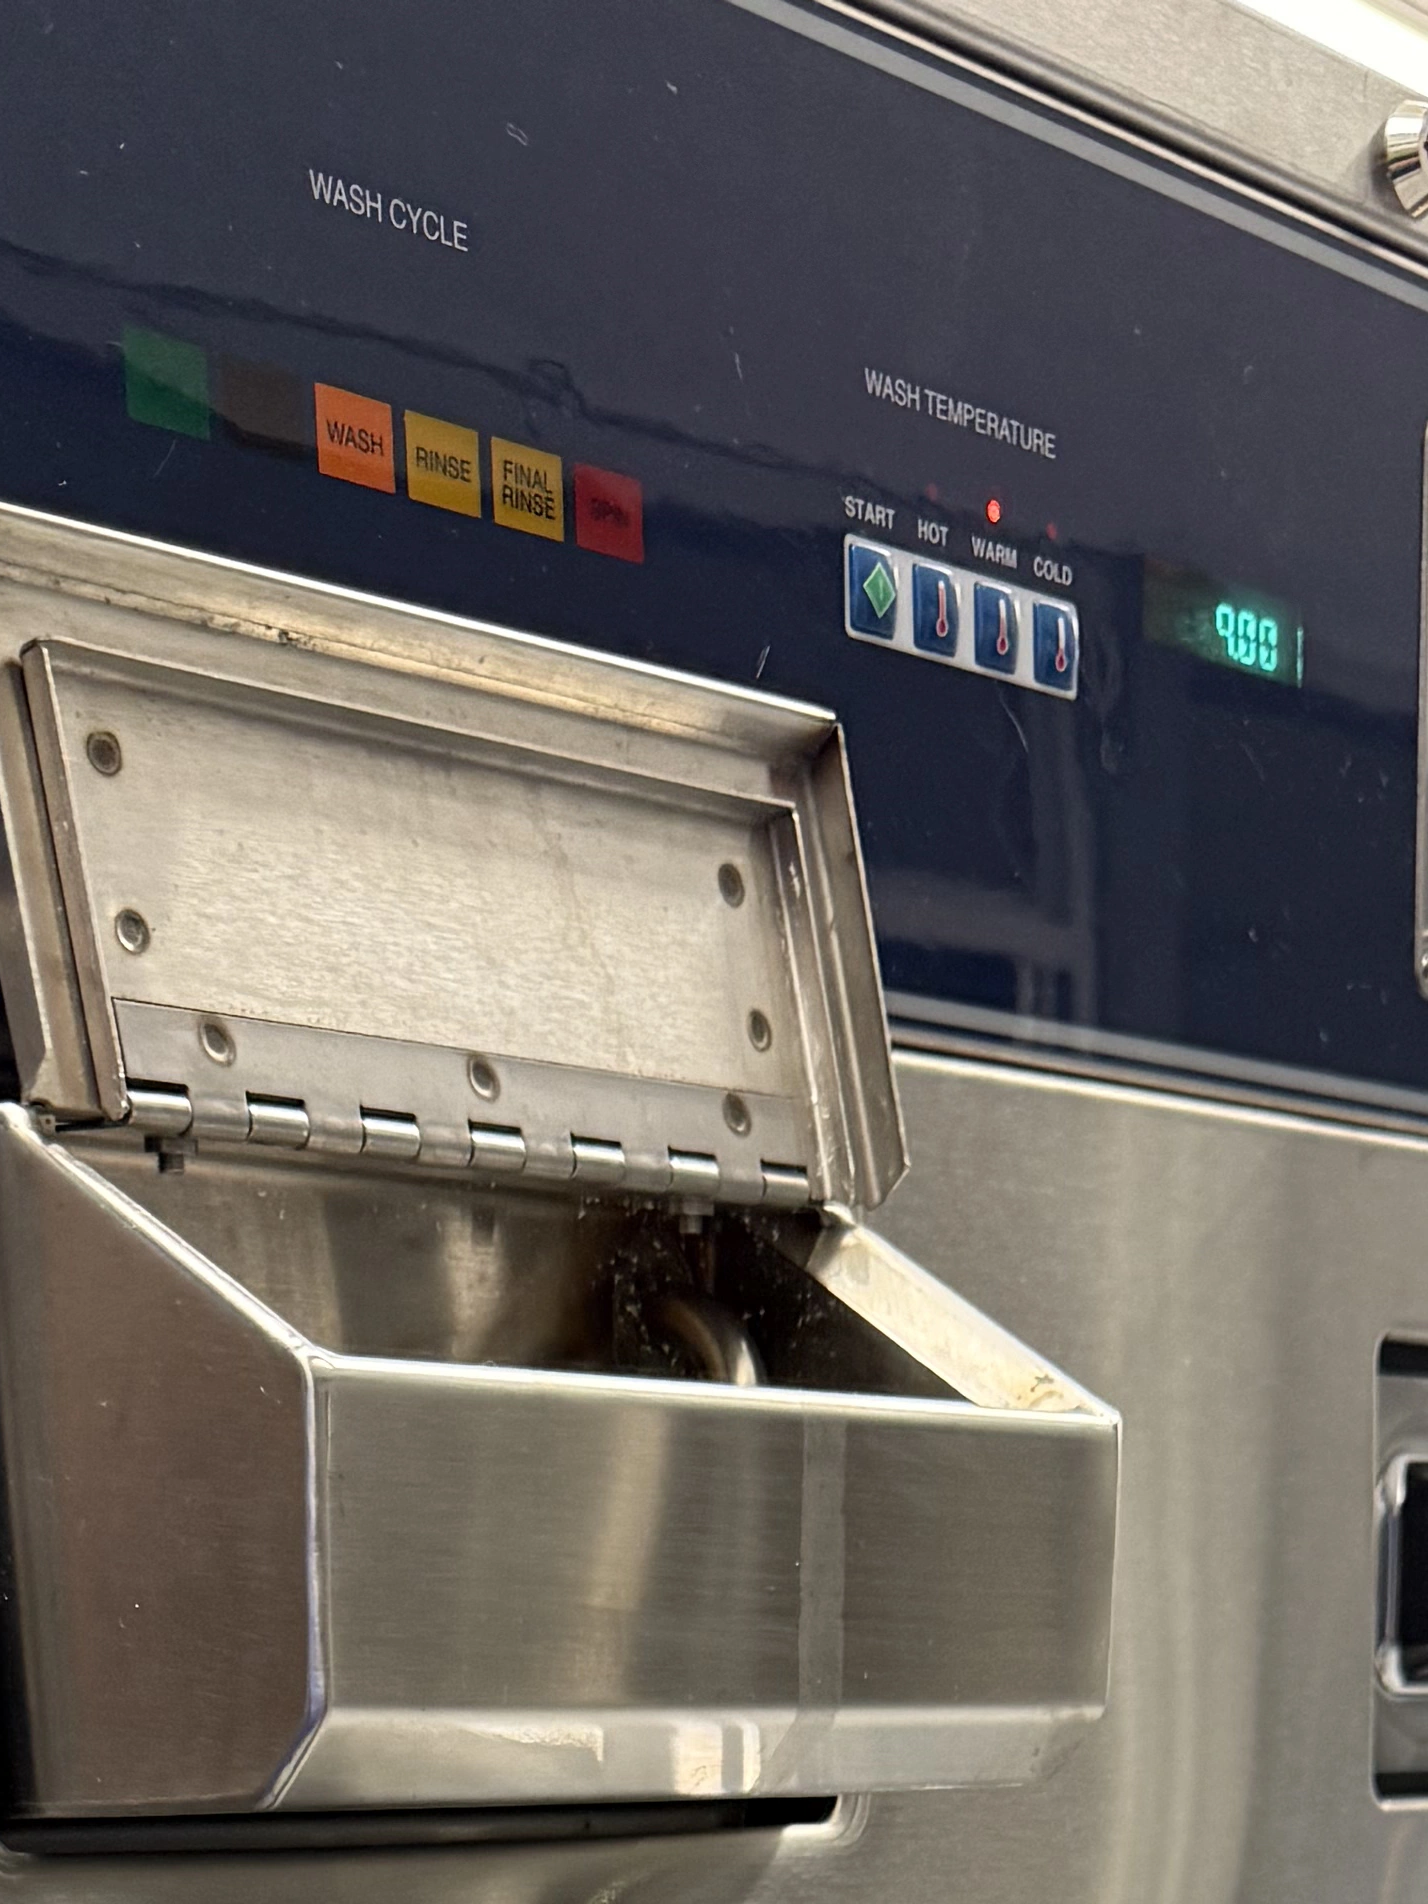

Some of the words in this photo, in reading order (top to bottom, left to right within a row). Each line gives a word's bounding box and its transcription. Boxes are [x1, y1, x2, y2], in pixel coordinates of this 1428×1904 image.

[309, 169, 382, 223] WASH
[389, 199, 468, 252] CYCLE
[865, 368, 920, 411] WASH
[924, 389, 1056, 459] TEMPERATURE
[326, 420, 385, 457] WASH
[415, 447, 472, 483] RINSE
[503, 460, 552, 495] FINAL
[502, 488, 557, 520] RINSE
[845, 496, 895, 530] START
[918, 519, 949, 547] HOT
[972, 536, 1018, 569] WARM
[1033, 556, 1072, 586] COLD
